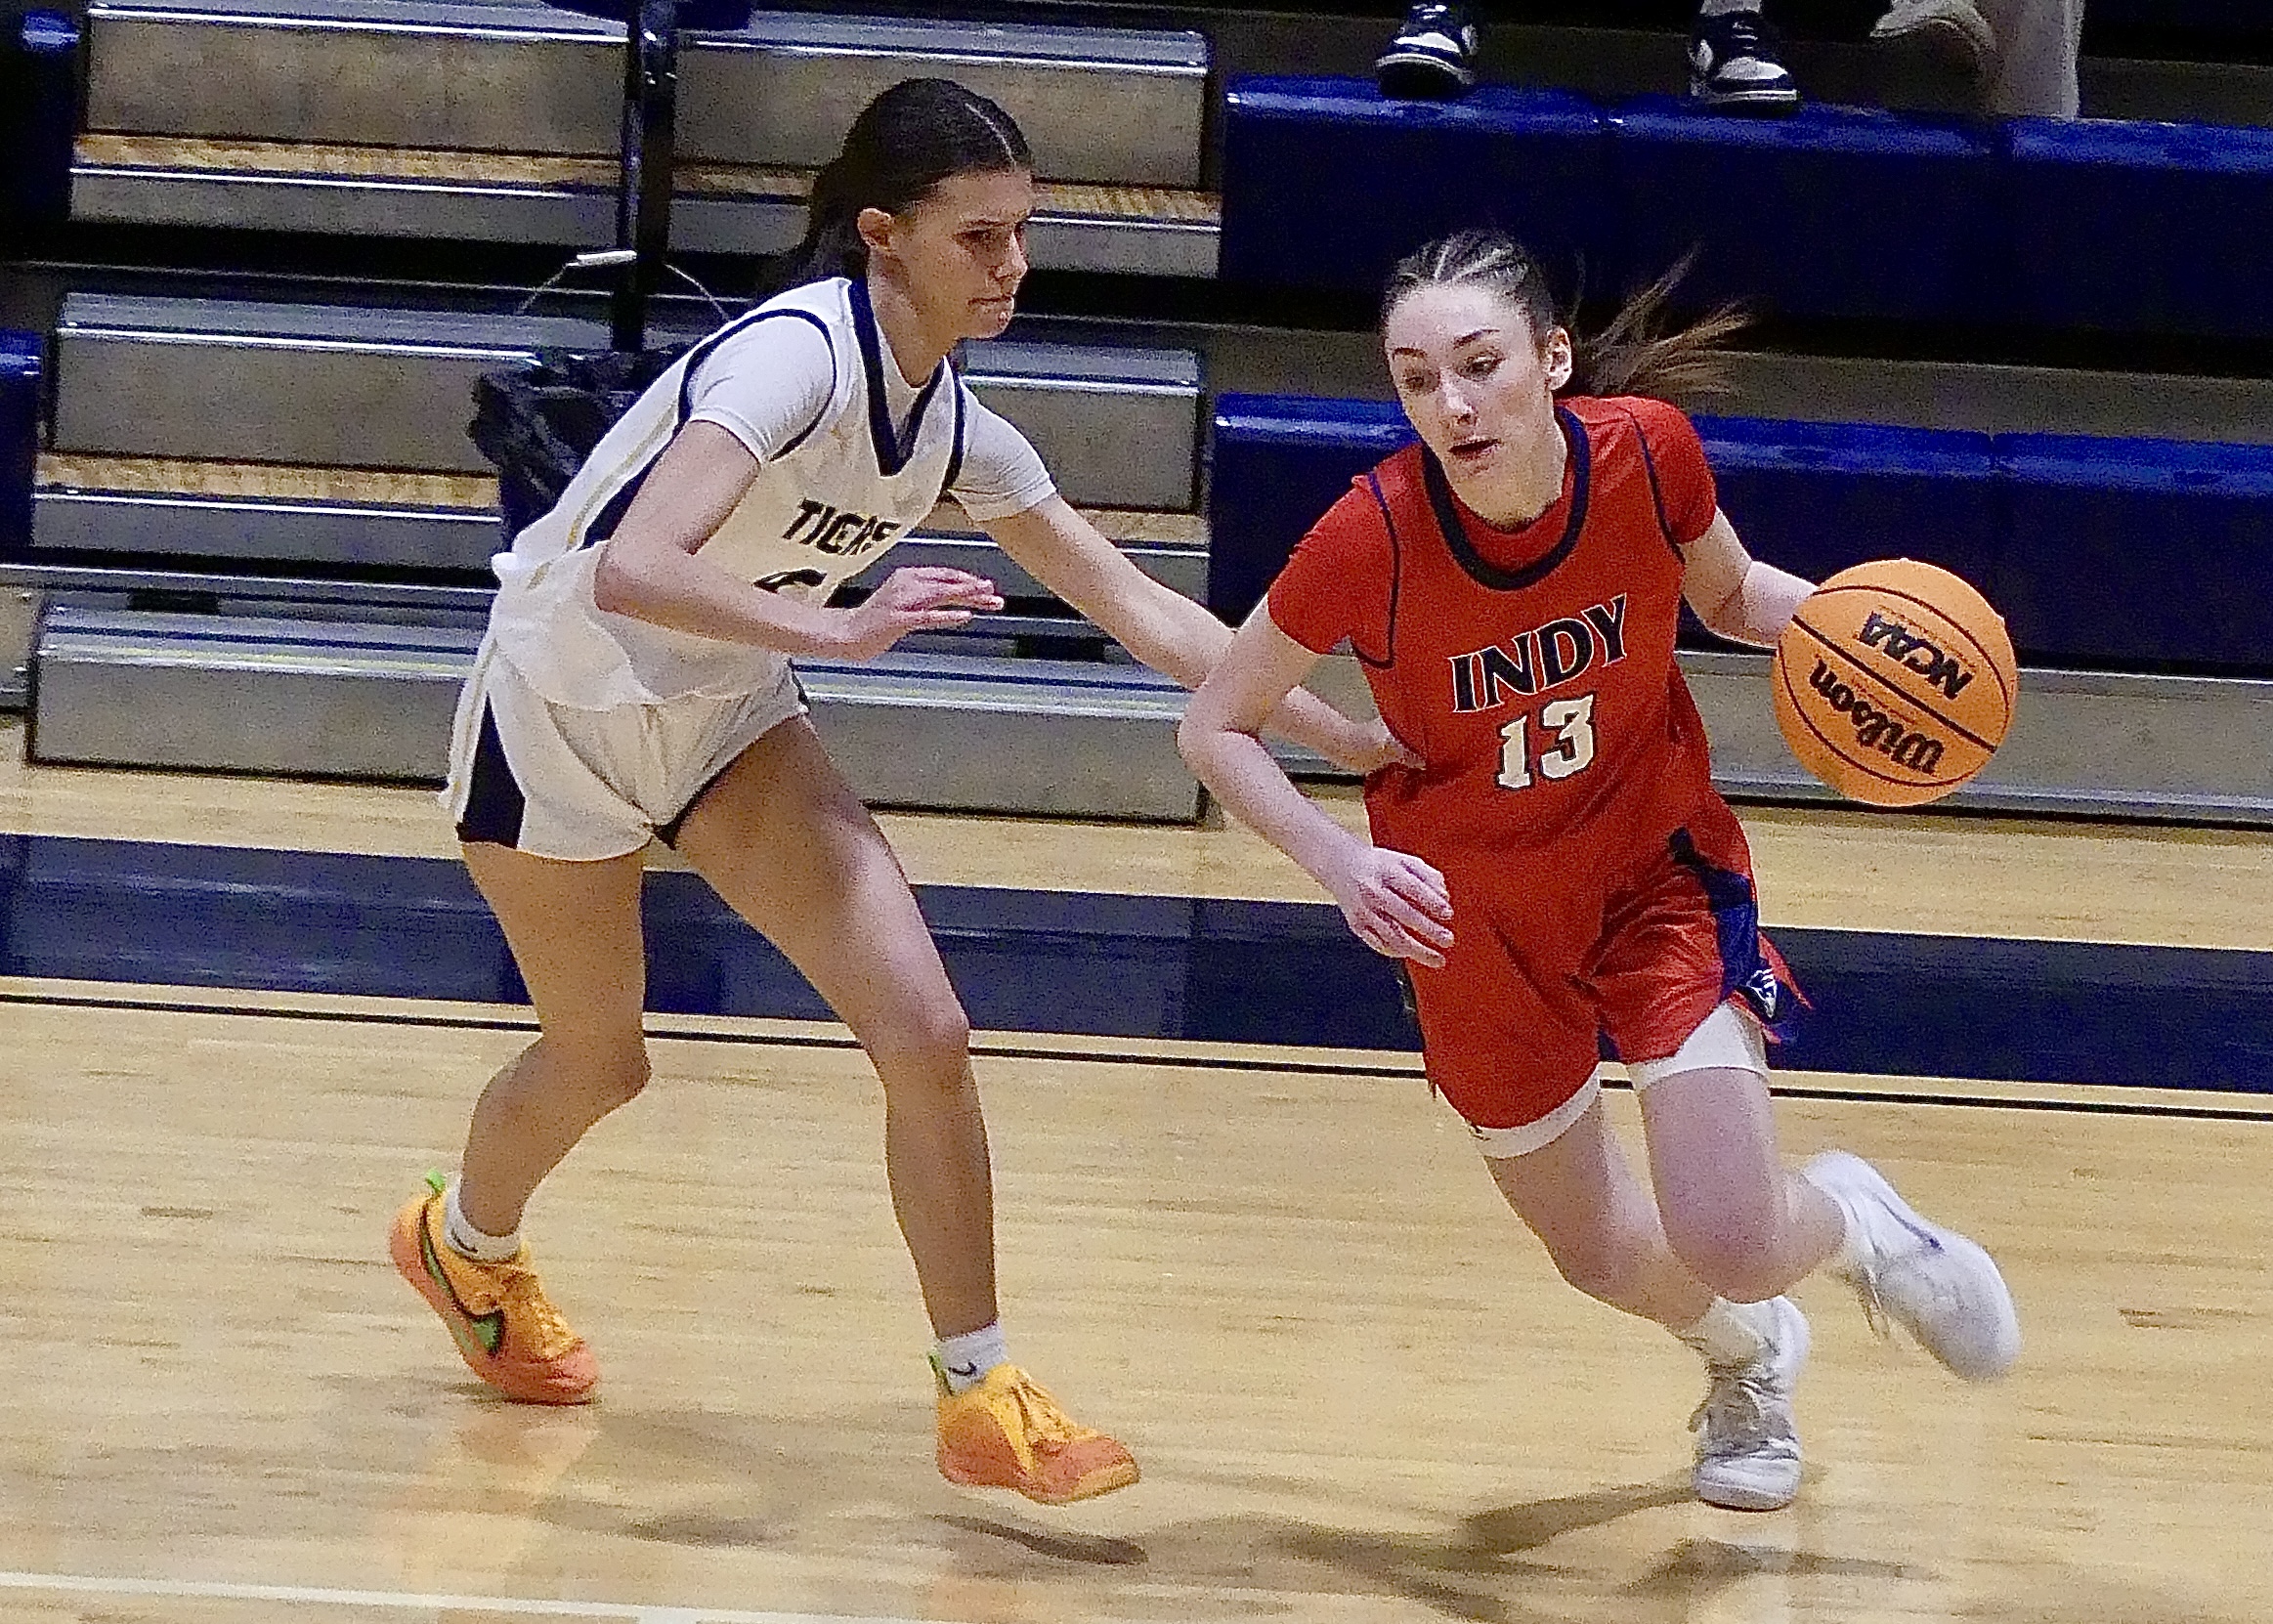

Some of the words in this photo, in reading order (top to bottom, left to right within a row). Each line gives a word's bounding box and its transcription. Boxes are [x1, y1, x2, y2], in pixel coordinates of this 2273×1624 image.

[782, 496, 901, 556] TIGRS
[1447, 591, 1628, 713] INDY
[1859, 610, 1974, 701] NCAA
[1495, 692, 1598, 791] 13
[1810, 656, 1945, 775] Wilson
